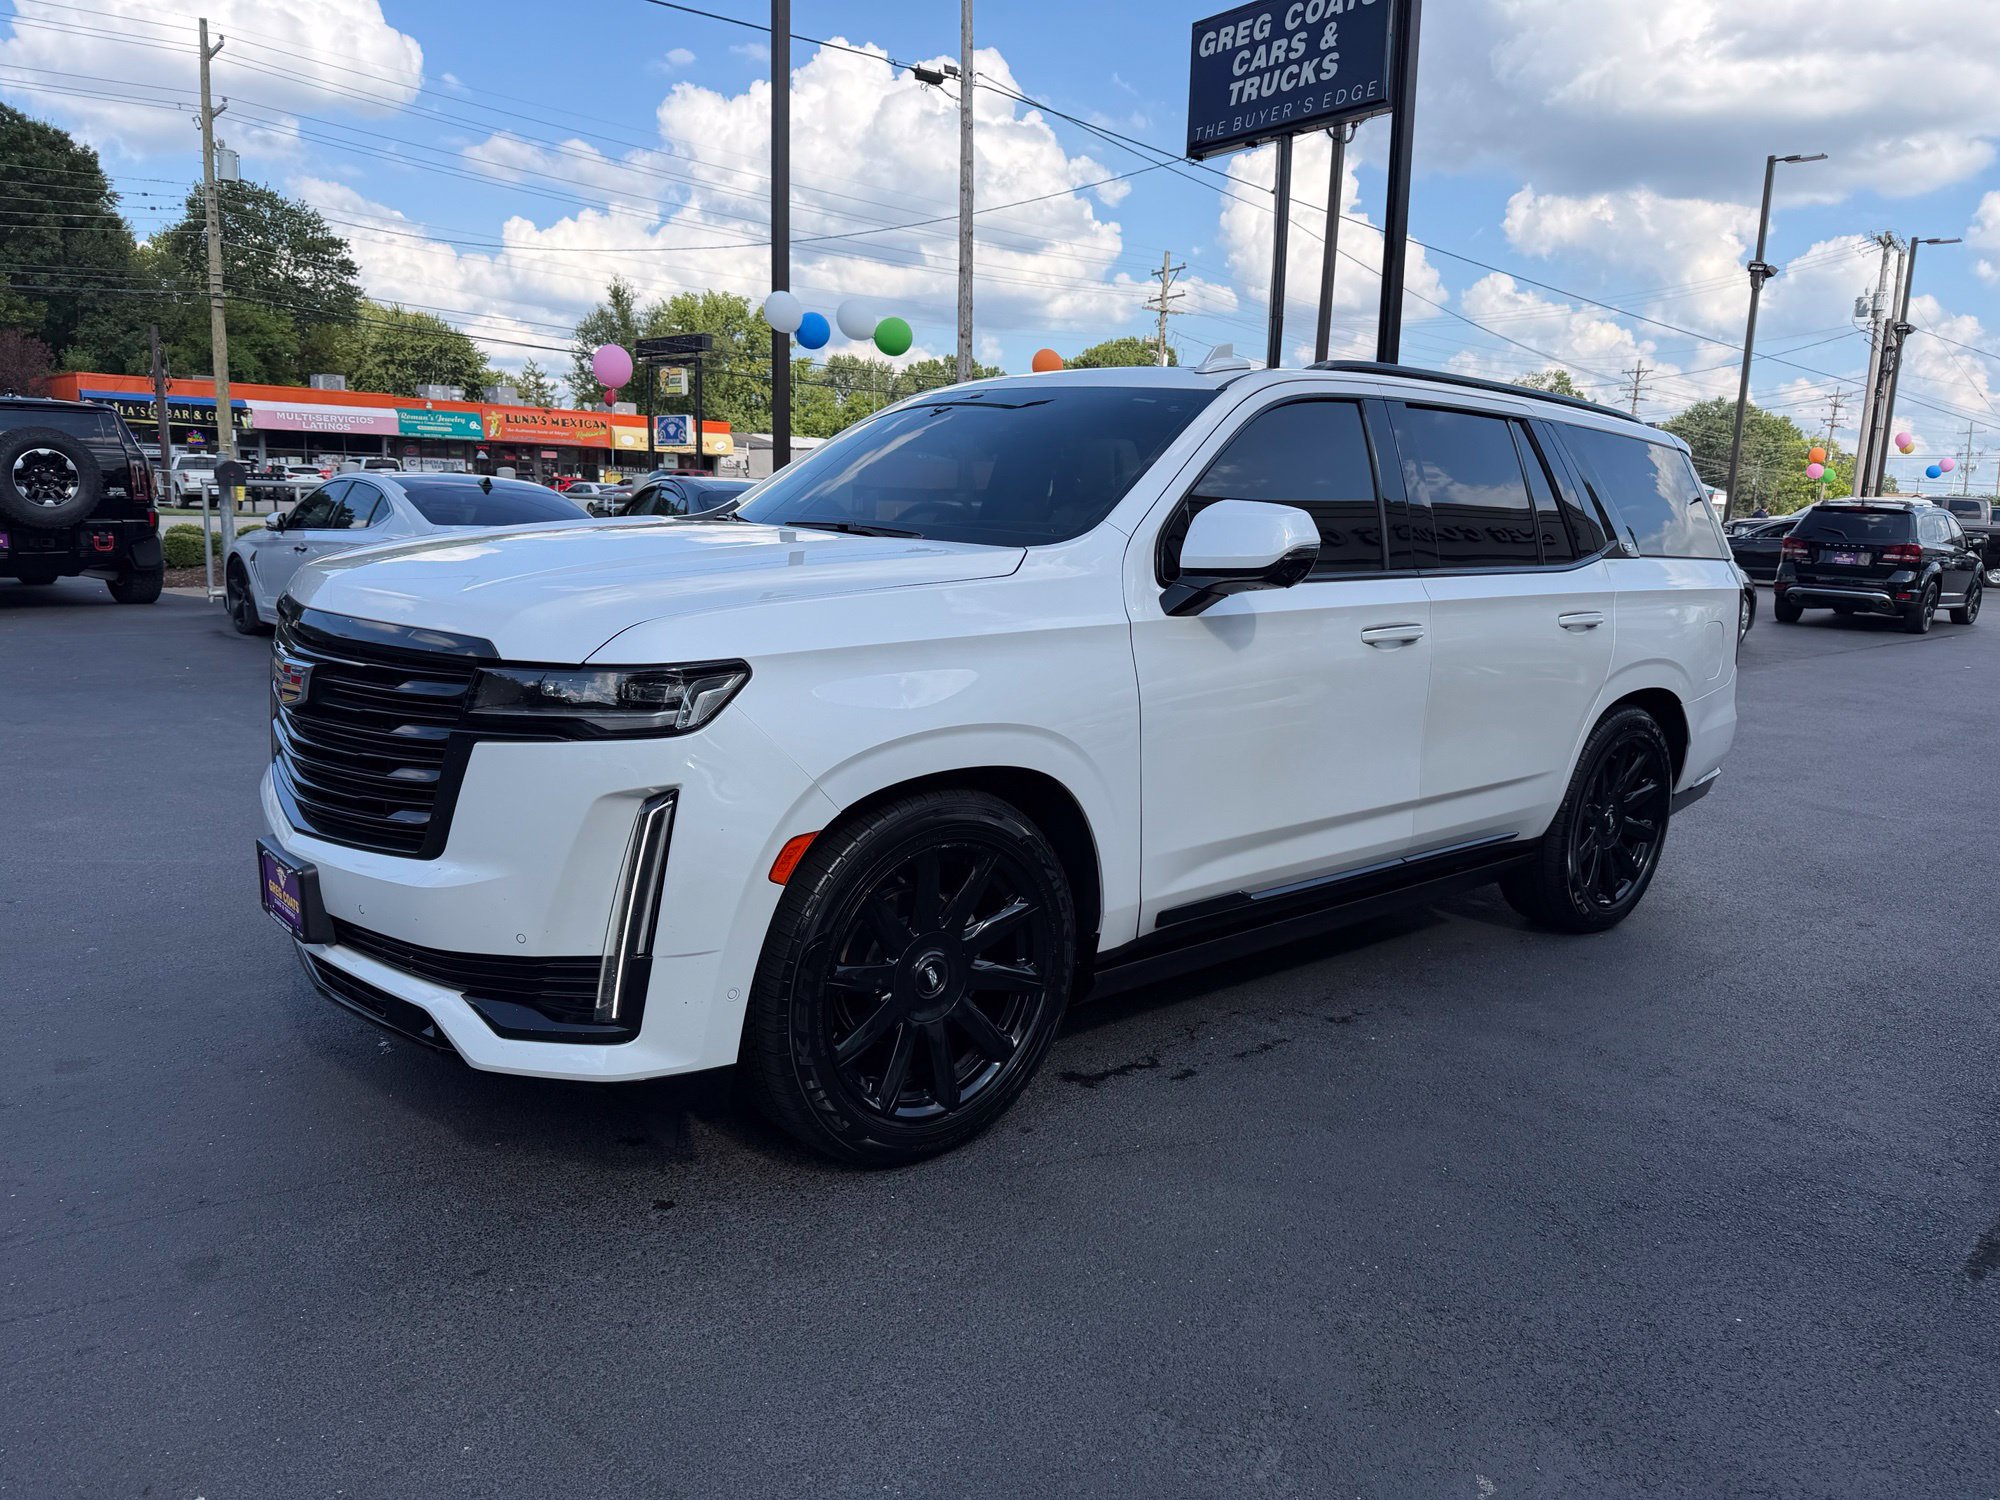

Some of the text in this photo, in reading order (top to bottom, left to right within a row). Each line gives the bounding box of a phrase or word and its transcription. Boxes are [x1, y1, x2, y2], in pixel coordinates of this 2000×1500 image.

[1199, 13, 1272, 57] GREG
[1232, 21, 1338, 76] CARS &
[1229, 52, 1340, 106] TRUCKS
[1195, 80, 1377, 141] THE BUYER'S EDGE
[167, 409, 189, 419] BAR
[193, 410, 202, 420] &
[276, 411, 374, 424] MULTI-SERVICIOS
[302, 421, 351, 431] LATINOS
[398, 411, 434, 421] Roman's
[435, 414, 466, 425] Jewelry
[505, 413, 607, 430] LUNA'S MEXICAN
[268, 879, 300, 914] GREG COATS
